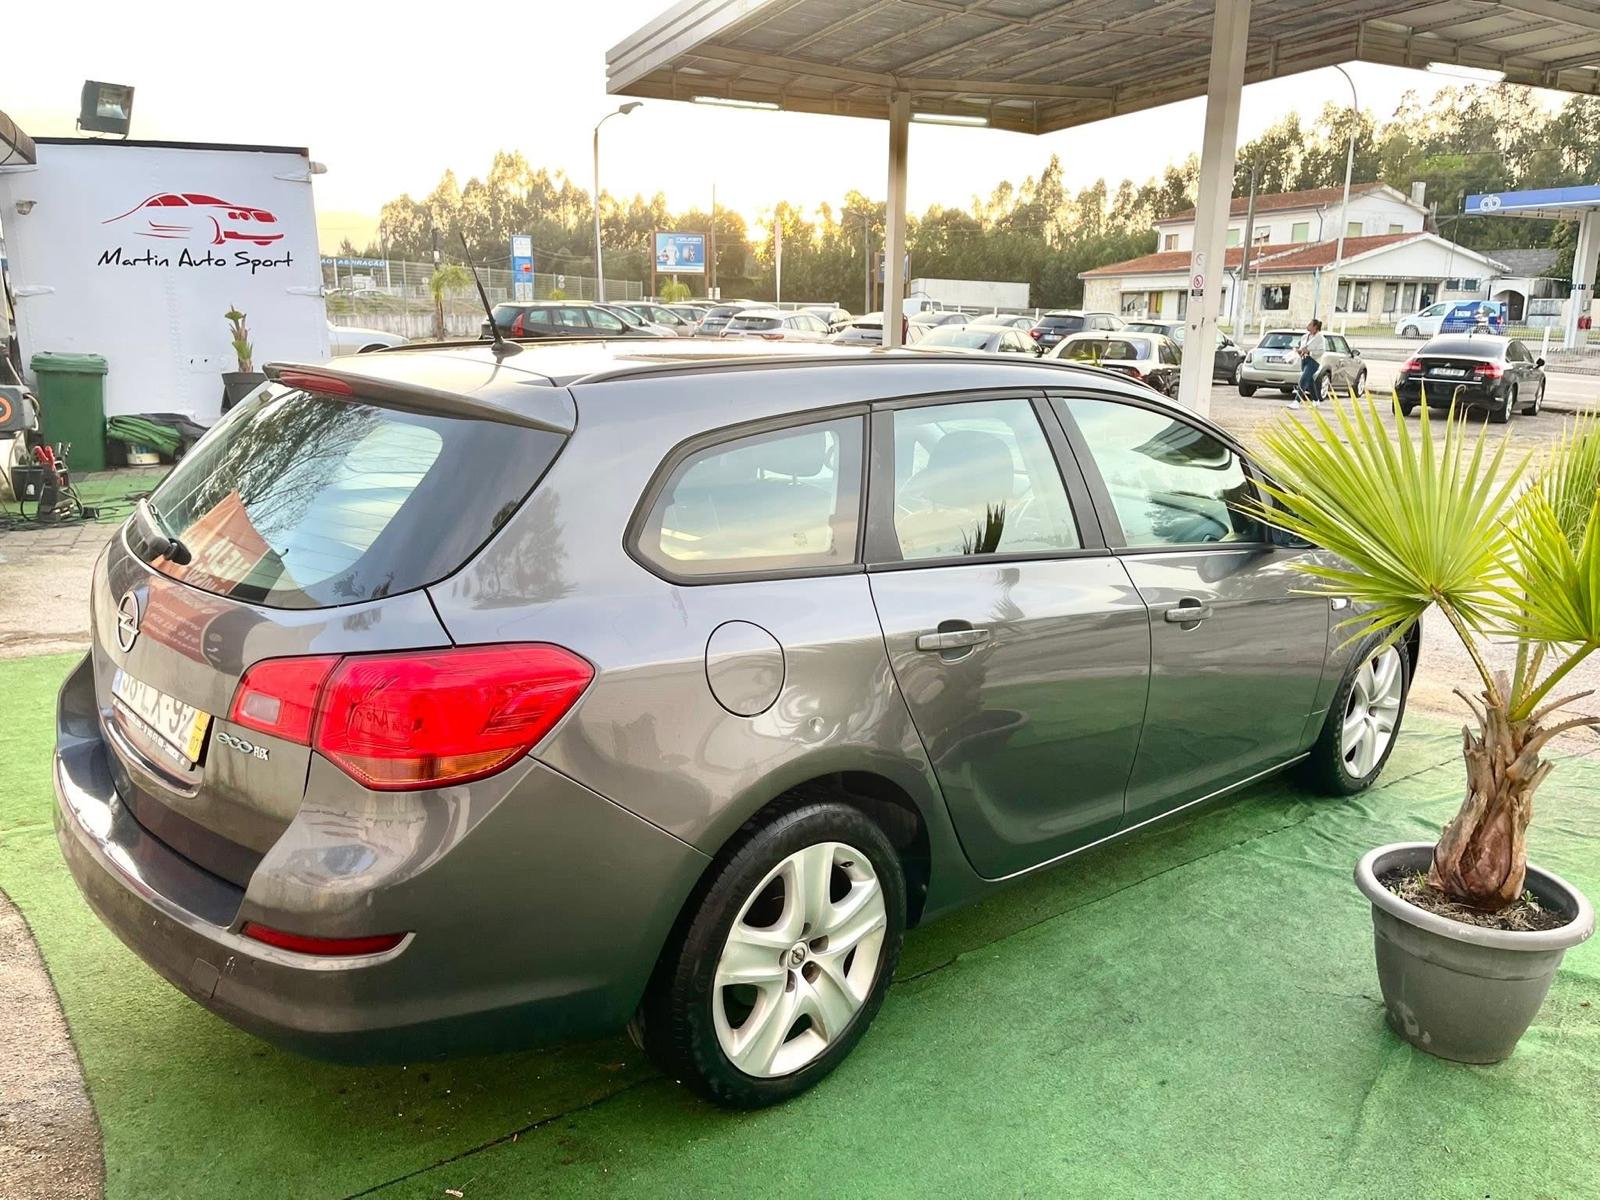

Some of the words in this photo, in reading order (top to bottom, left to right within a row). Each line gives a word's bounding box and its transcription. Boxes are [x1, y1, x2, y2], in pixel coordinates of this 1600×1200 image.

[98, 247, 169, 267] Martin
[178, 248, 227, 267] Auto
[234, 250, 293, 275] Sport
